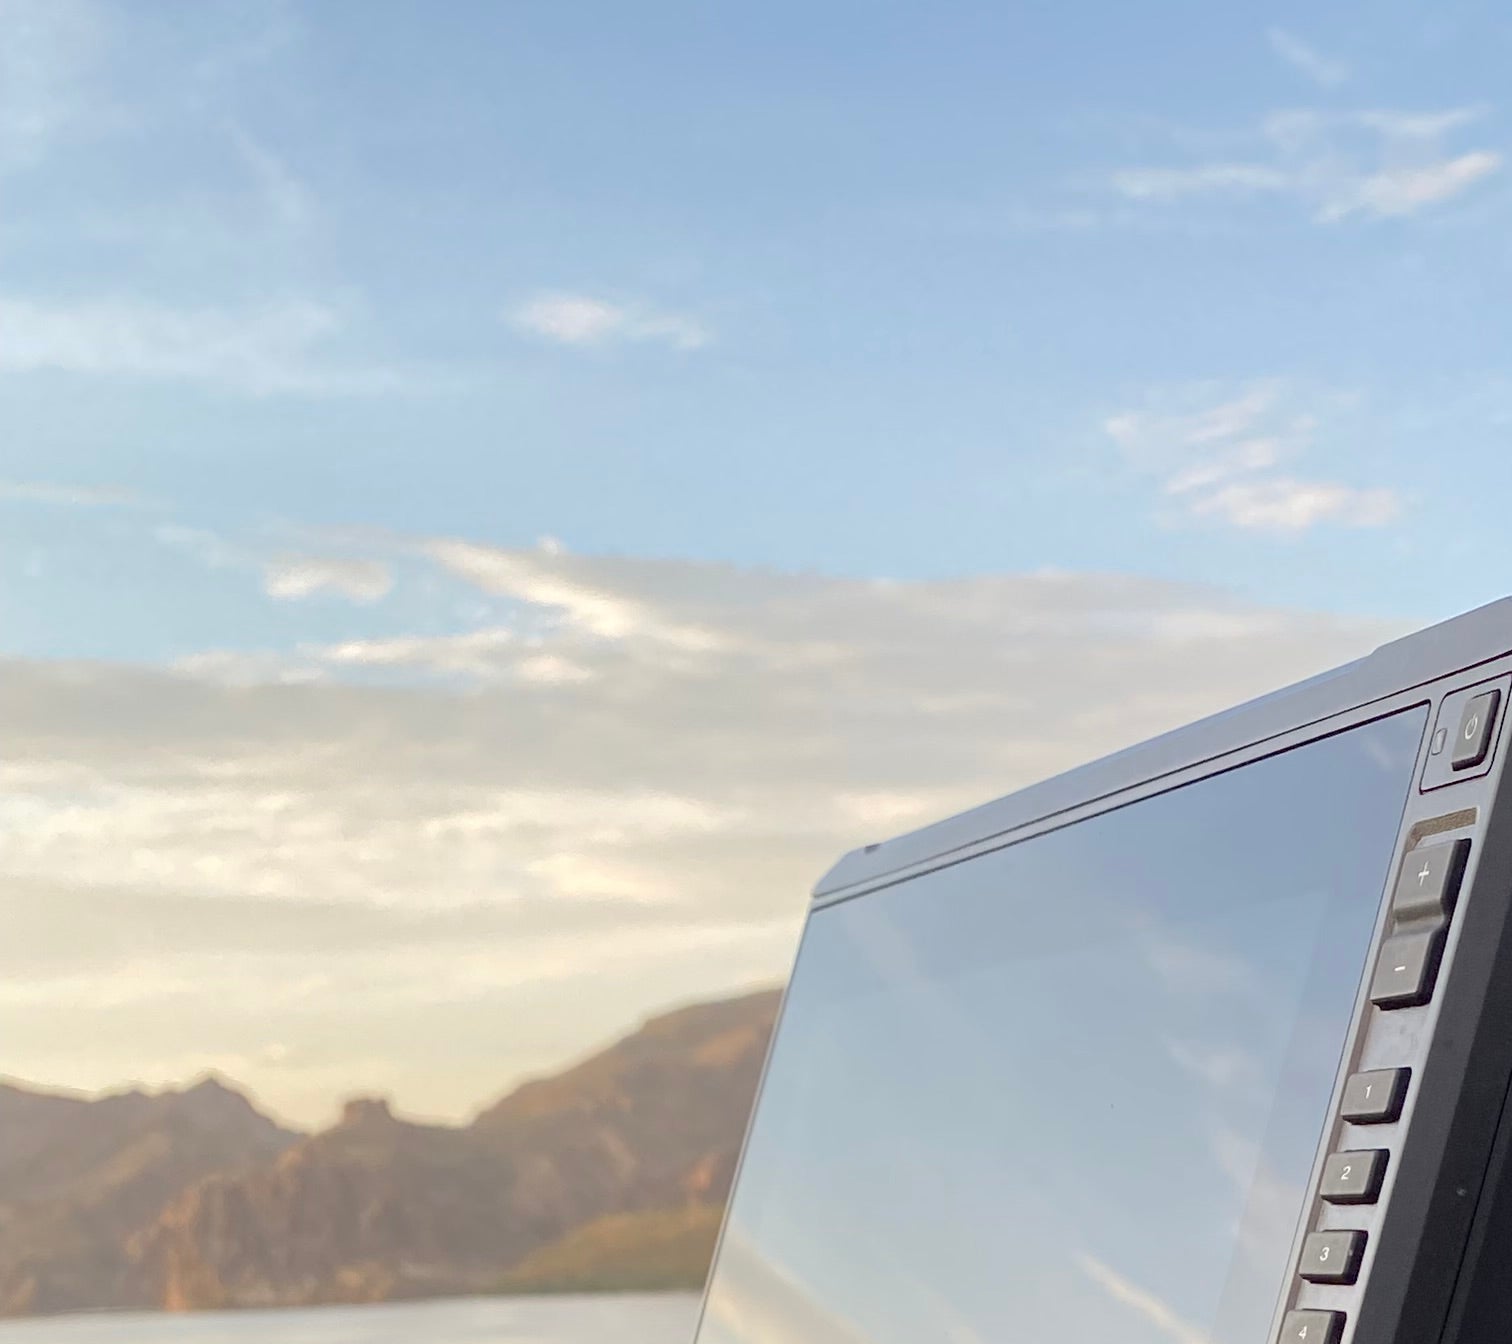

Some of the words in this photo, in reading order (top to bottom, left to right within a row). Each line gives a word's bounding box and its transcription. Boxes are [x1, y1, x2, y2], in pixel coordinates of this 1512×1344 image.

[1364, 1084, 1373, 1100] 1
[1340, 1164, 1352, 1181] 2
[1319, 1246, 1330, 1262] 3
[1298, 1325, 1308, 1341] 4
